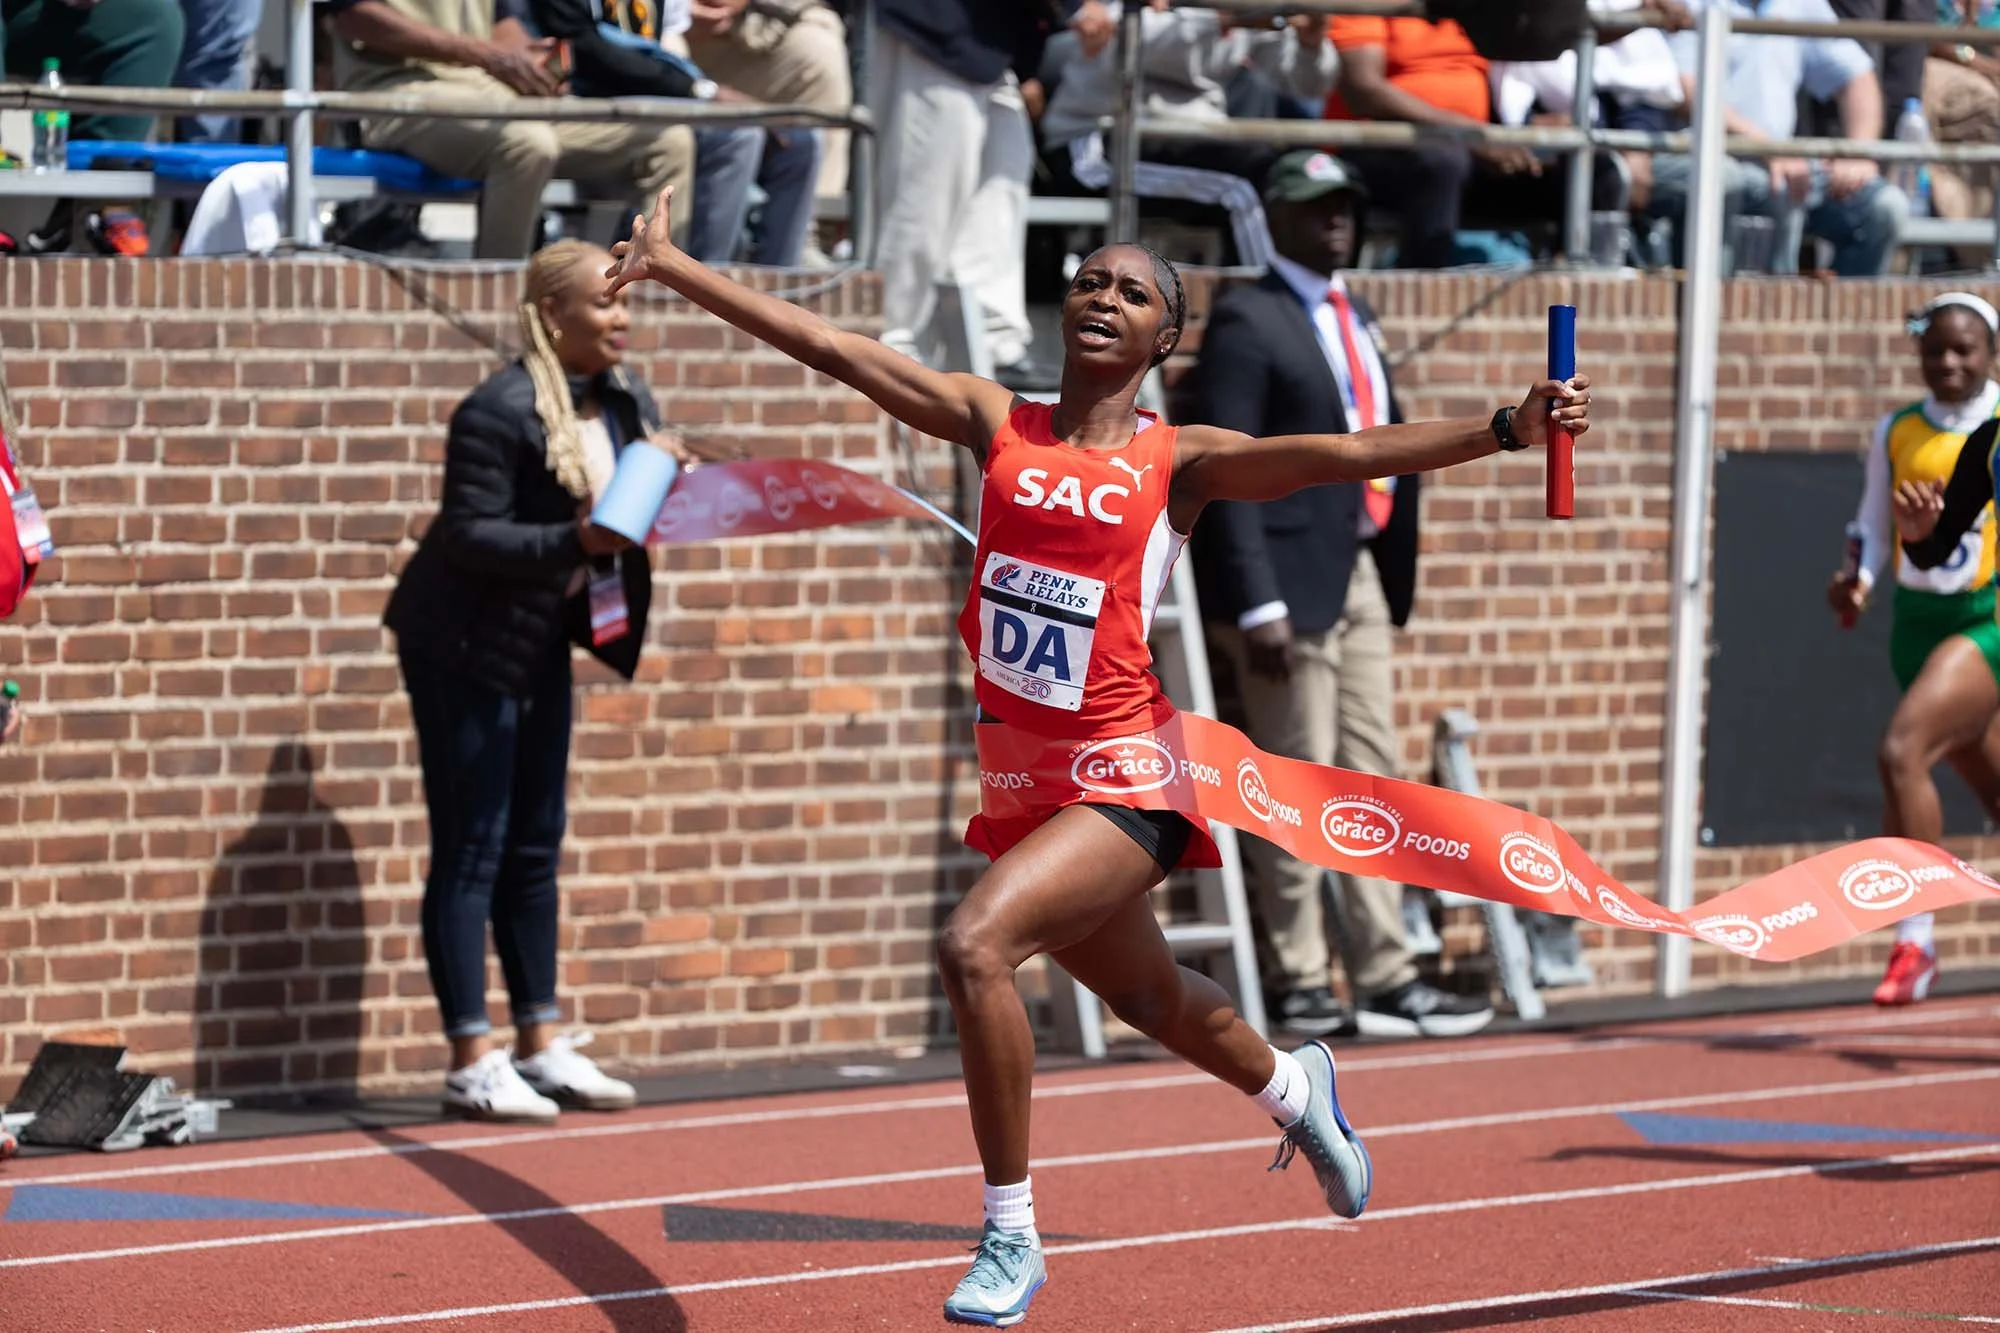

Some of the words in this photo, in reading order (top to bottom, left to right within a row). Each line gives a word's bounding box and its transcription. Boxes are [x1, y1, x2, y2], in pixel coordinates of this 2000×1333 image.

[1013, 467, 1130, 525] SAC
[1024, 582, 1088, 609] RELAYS
[1028, 570, 1077, 592] PENN
[992, 608, 1071, 682] DA
[1020, 677, 1052, 699] 250
[980, 769, 1035, 789] FOODS
[1086, 757, 1165, 780] Grace
[1180, 759, 1221, 788] FOODS
[1271, 798, 1302, 827] FOODS
[1322, 794, 1359, 809] QUALITY
[1359, 794, 1386, 808] SINCE
[1329, 815, 1386, 843] Grace
[1403, 831, 1471, 861] FOODS
[1509, 850, 1555, 881] Grace
[1854, 875, 1906, 901] Grace
[1760, 900, 1818, 933] FOODS
